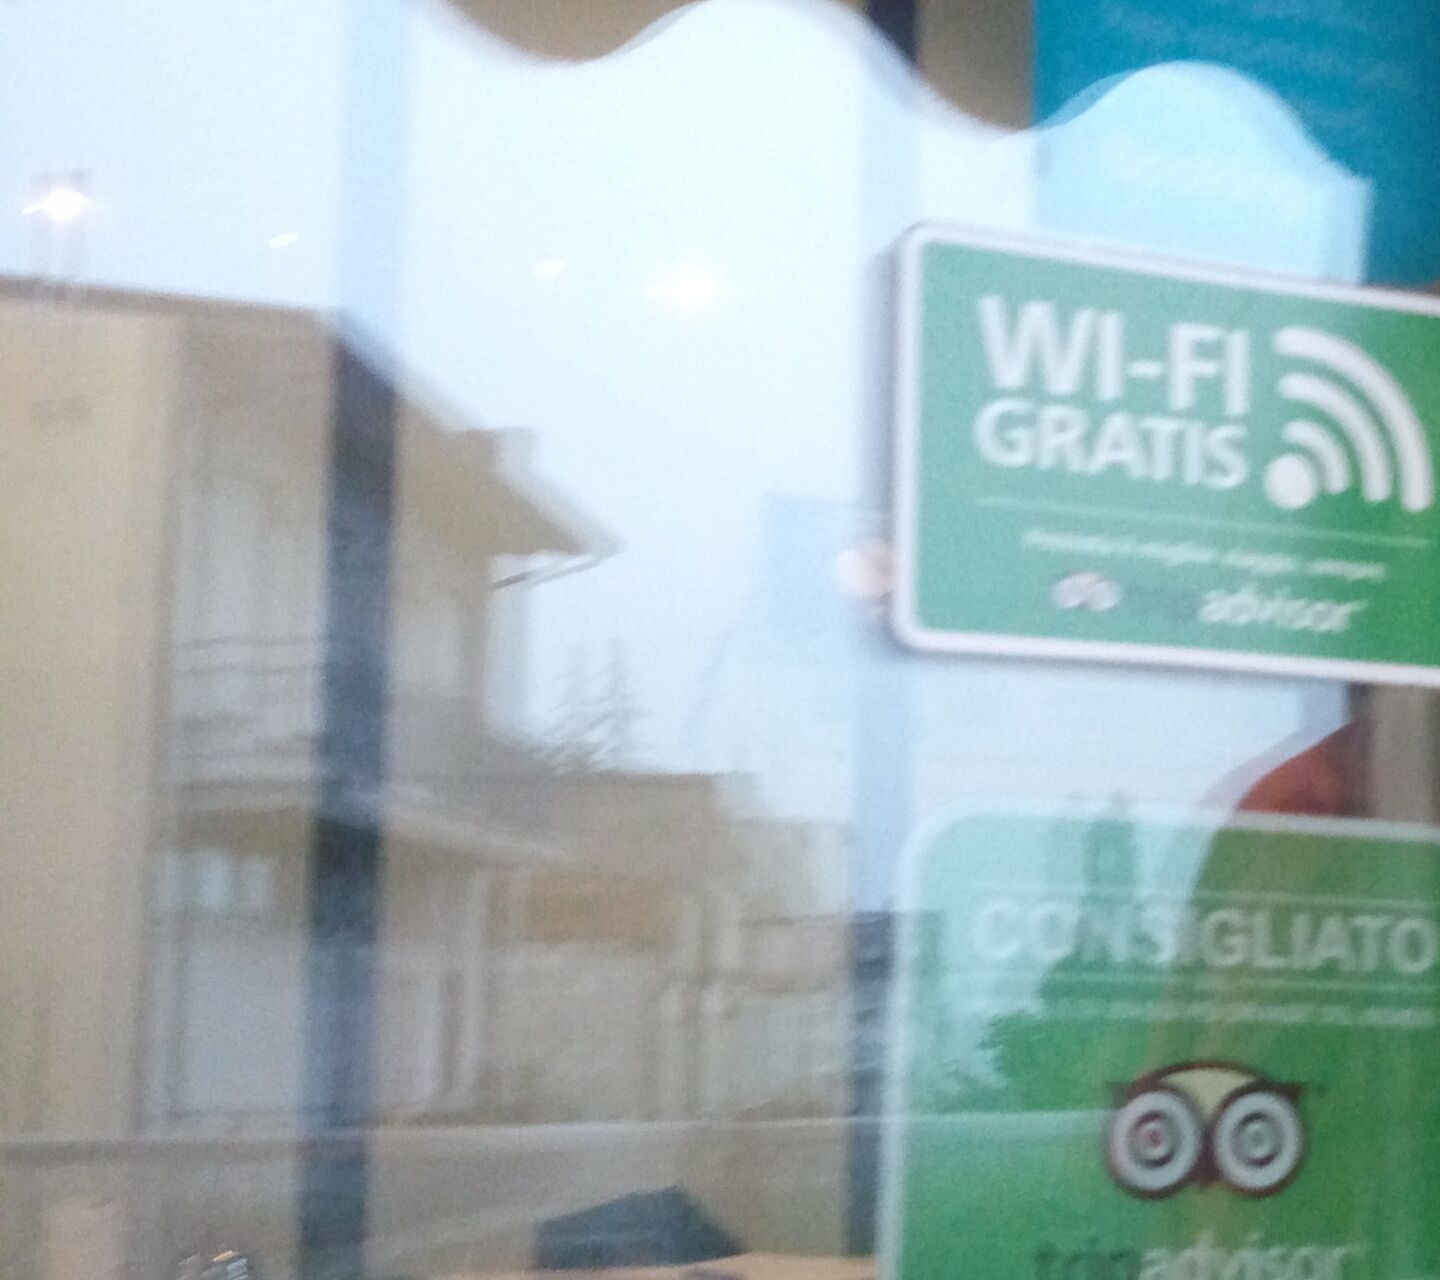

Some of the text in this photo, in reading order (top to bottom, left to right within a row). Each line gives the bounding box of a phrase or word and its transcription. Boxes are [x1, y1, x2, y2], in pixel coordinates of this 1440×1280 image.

[976, 294, 1251, 418] WI-FI
[971, 397, 1249, 490] GRATIS
[971, 897, 1440, 976] CONSIGLIATO
